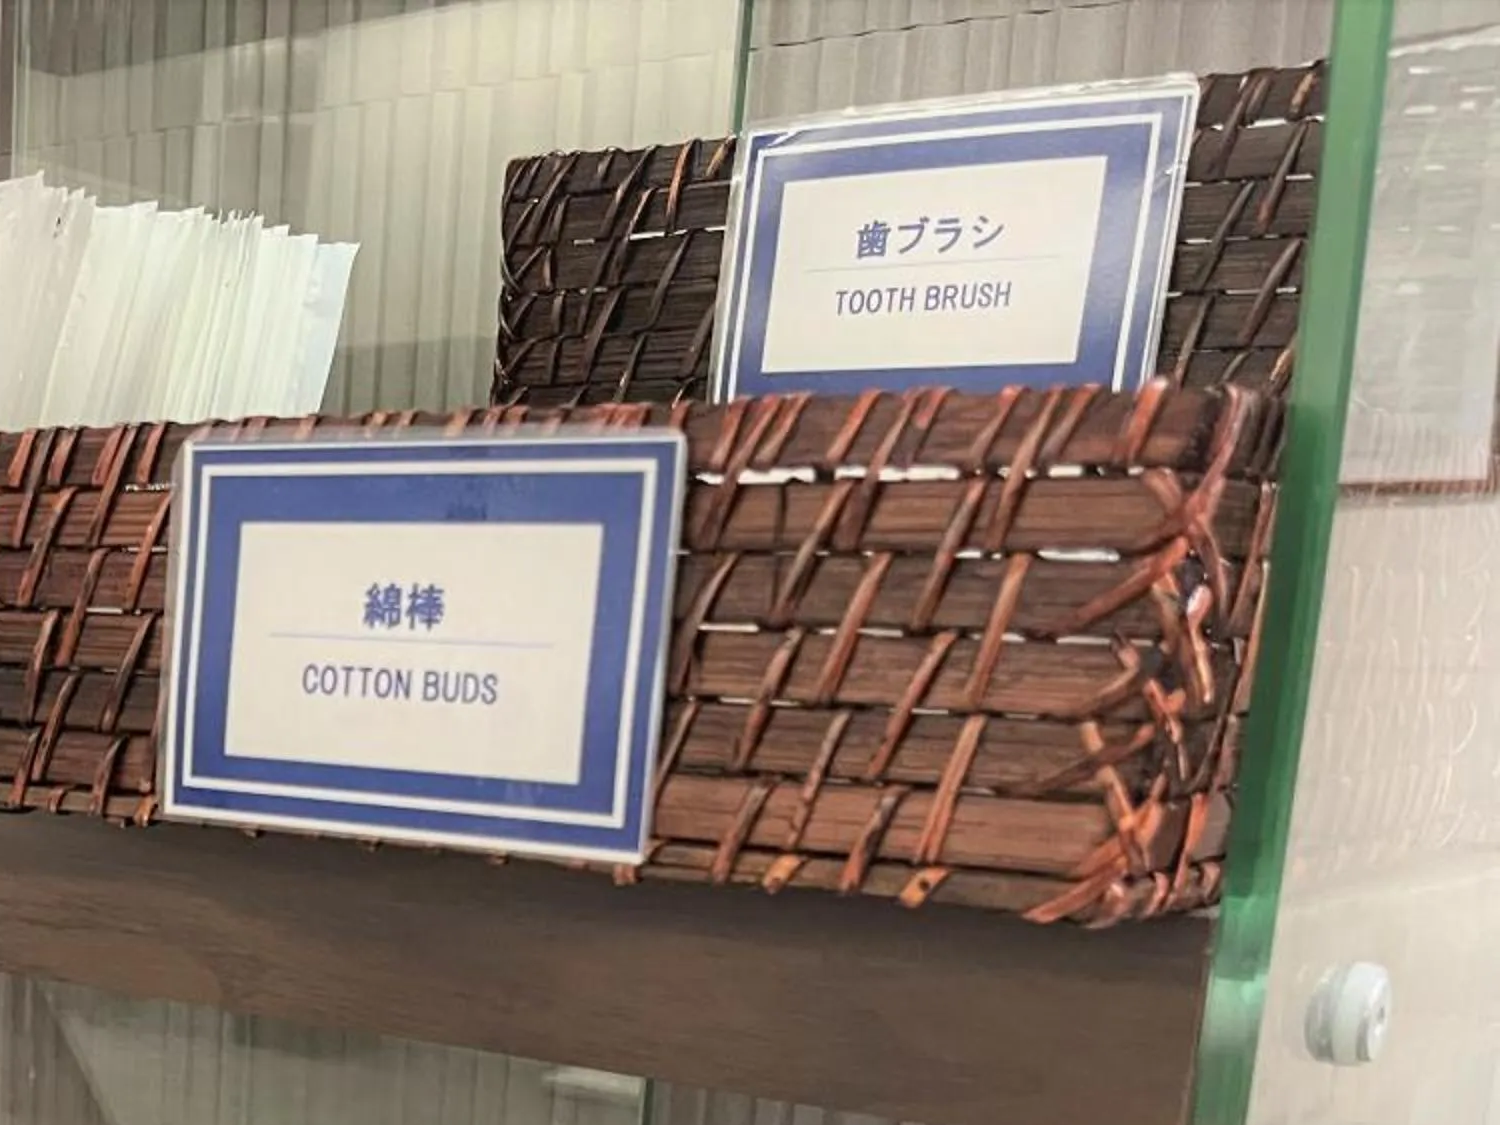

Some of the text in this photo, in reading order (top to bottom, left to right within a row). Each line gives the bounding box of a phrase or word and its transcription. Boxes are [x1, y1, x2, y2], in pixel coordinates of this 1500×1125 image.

[856, 213, 1005, 260] 歯ブラシ
[835, 281, 1013, 316] TOOTH BRUSH
[362, 582, 446, 631] 綿棒
[302, 663, 499, 705] COTTON BUDS
